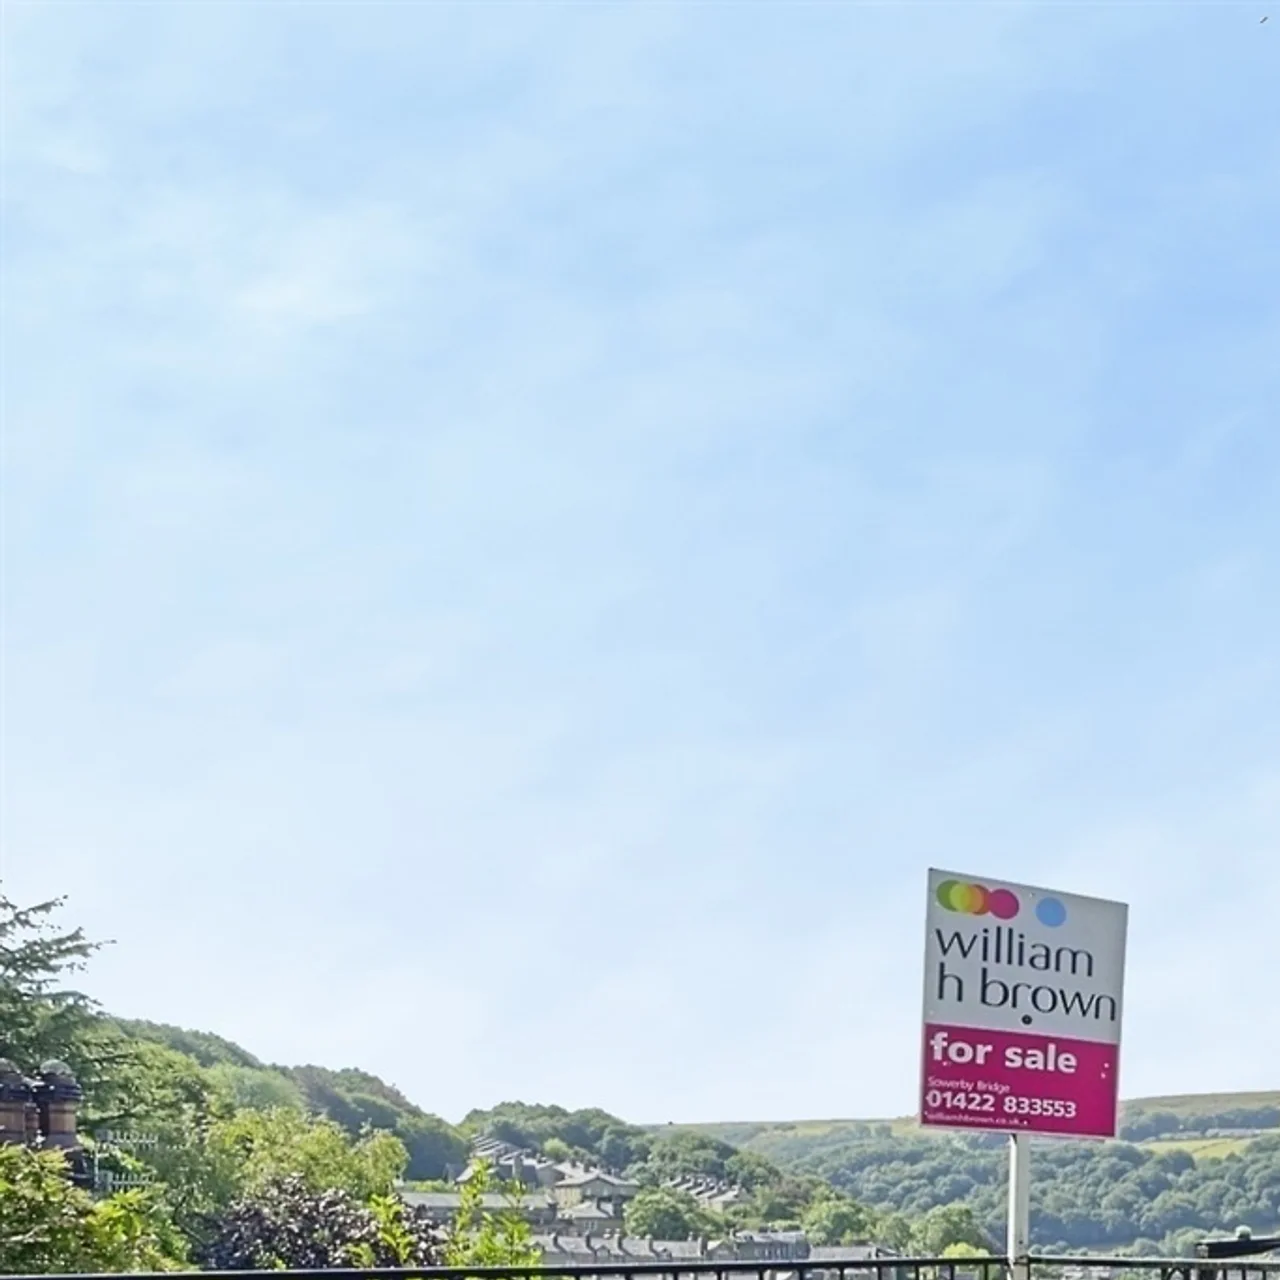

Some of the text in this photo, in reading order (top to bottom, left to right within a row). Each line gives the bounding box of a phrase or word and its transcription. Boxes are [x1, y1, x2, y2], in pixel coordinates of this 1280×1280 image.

[936, 926, 1093, 977] william
[938, 962, 1116, 1021] h brown
[930, 1032, 1077, 1073] for sale
[926, 1089, 1077, 1118] 01422 833553
[927, 1076, 1010, 1094] Sowerby Bridge
